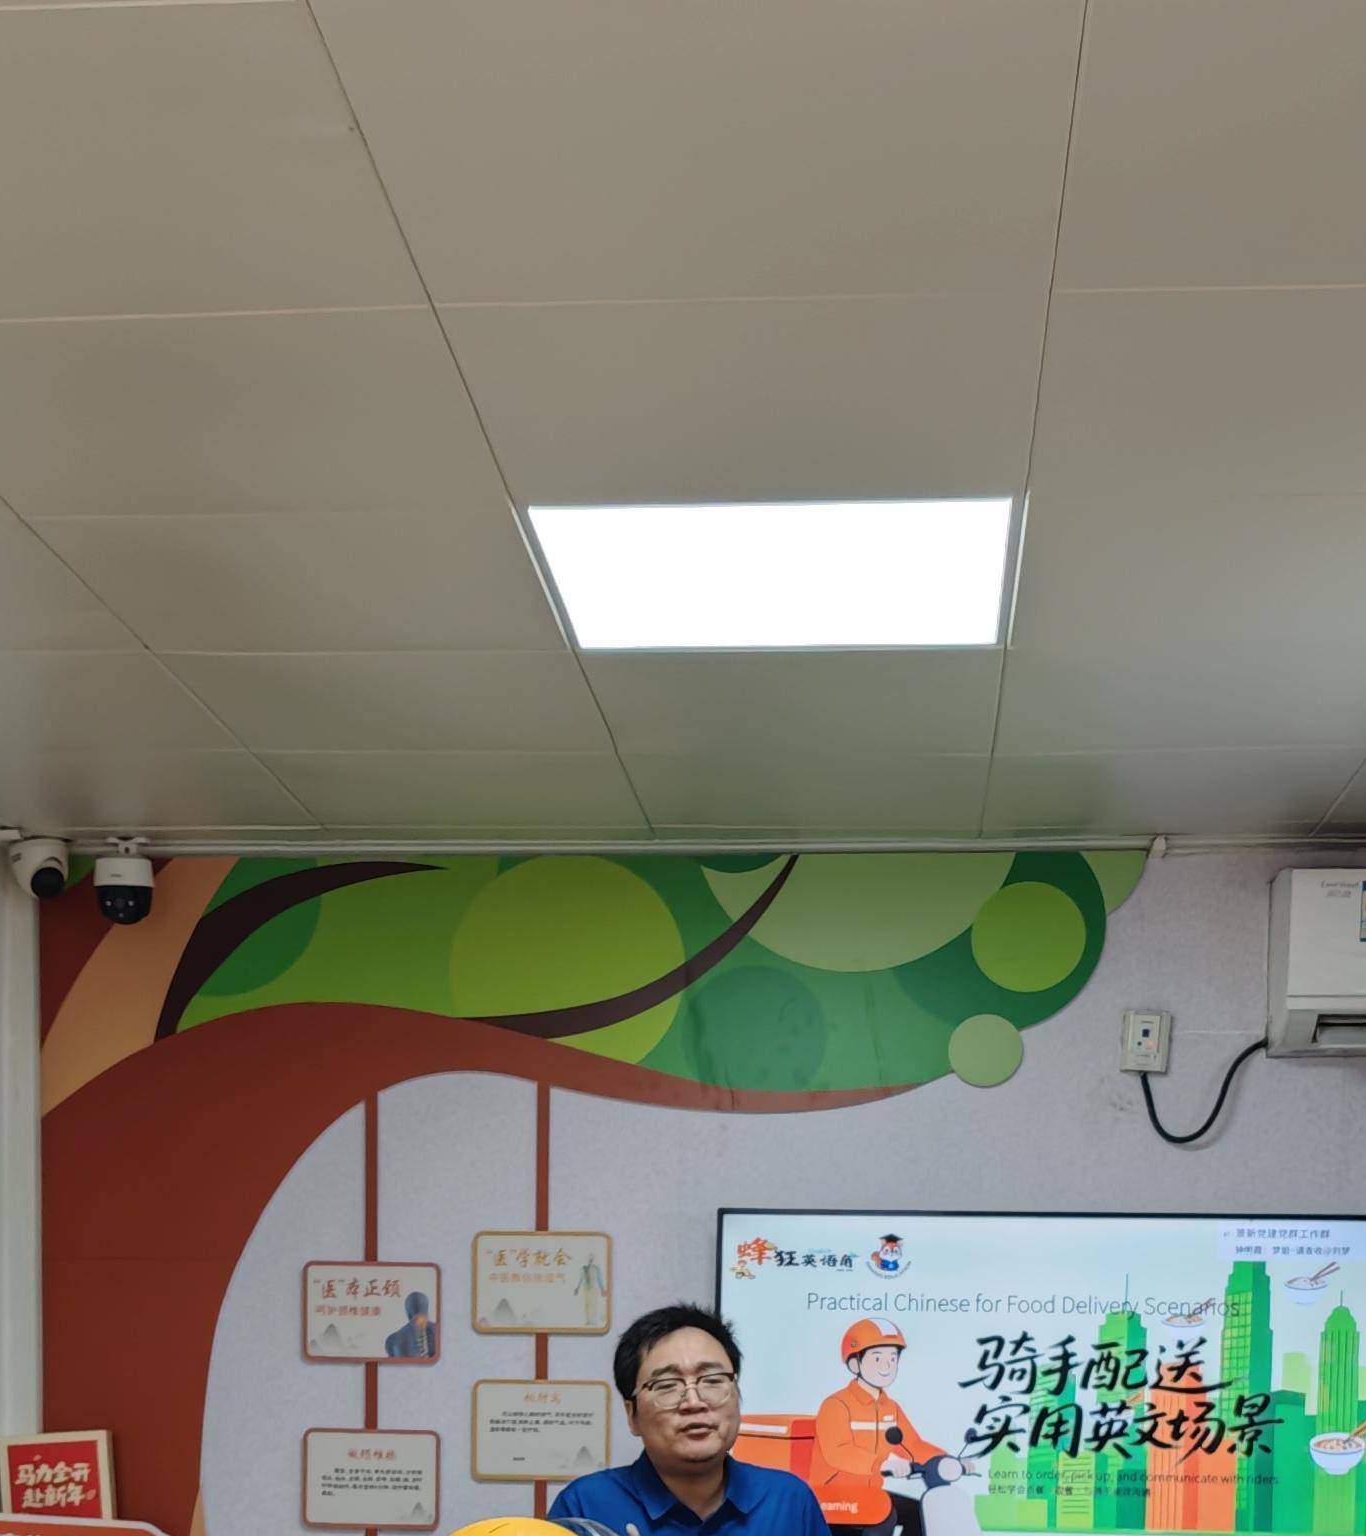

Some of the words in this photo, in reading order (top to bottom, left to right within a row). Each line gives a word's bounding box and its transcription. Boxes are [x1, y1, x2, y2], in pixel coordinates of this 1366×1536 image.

[737, 1237, 854, 1268] 蜂狂英语角
[807, 1291, 888, 1313] Practical
[894, 1293, 971, 1313] Chinese
[975, 1293, 1003, 1313] for
[1007, 1295, 1056, 1314] Food
[1062, 1296, 1139, 1319] Delivery
[1144, 1297, 1240, 1318] Scenarios
[957, 1329, 1233, 1394] 骑手配送
[965, 1393, 1284, 1466] 实用英文场景
[15, 1461, 91, 1486] 马力全开
[988, 1469, 1018, 1480] Learn
[1021, 1470, 1033, 1480] to
[1139, 1472, 1219, 1484] communicate
[1221, 1473, 1245, 1484] with
[22, 1483, 87, 1508] 赴新年
